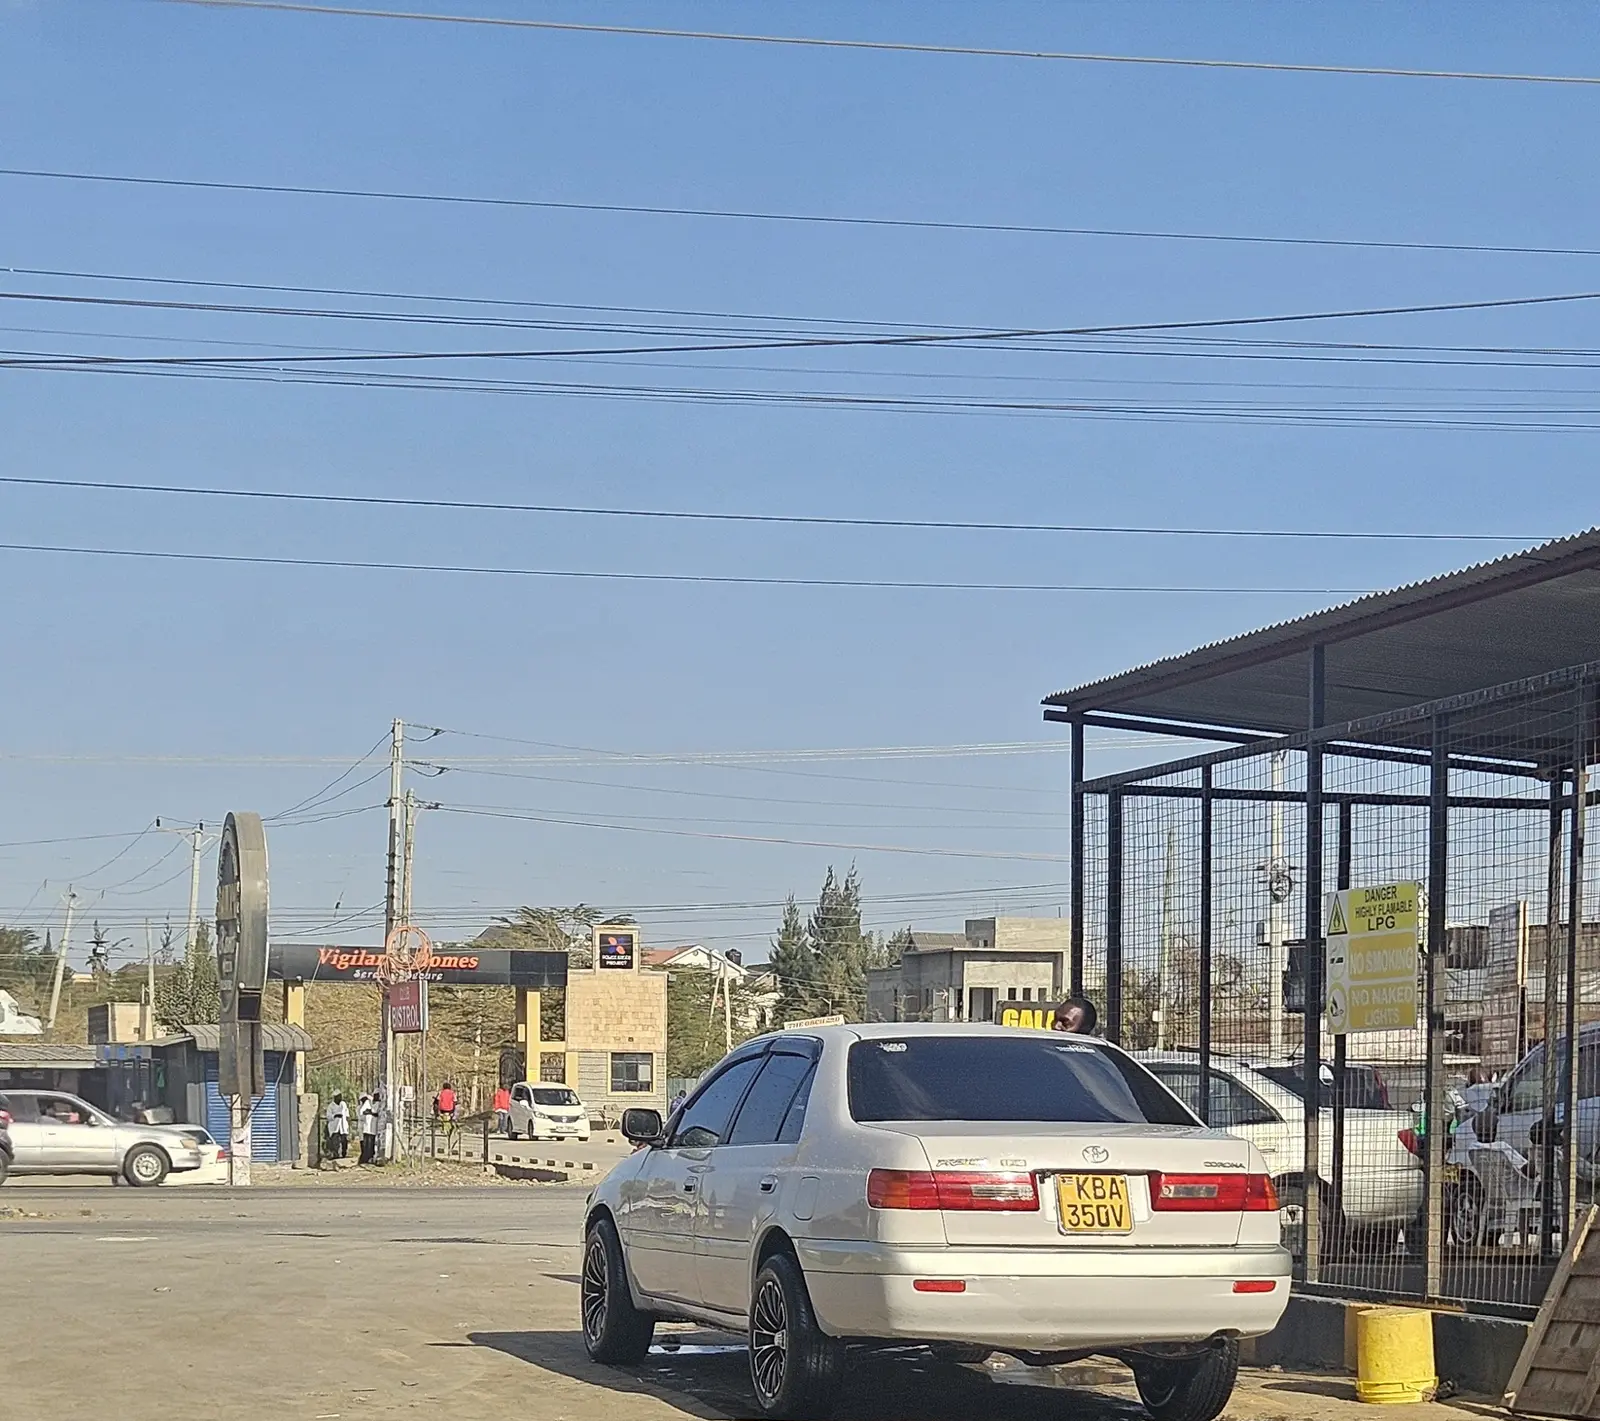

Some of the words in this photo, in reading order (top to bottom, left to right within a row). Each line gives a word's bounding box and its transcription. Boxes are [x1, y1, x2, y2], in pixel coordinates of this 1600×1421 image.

[1364, 886, 1397, 903] DANGER
[1355, 904, 1377, 919] HIGHLY
[1378, 900, 1413, 916] FLAMABLE
[1367, 915, 1396, 931] LPG
[1350, 952, 1365, 975] NO
[1366, 946, 1414, 973] SMOKING
[1351, 989, 1369, 1006] NO
[1371, 986, 1414, 1005] NAKED
[1364, 1007, 1400, 1026] LIGHTS
[1075, 1177, 1122, 1200] KBA
[1066, 1204, 1124, 1228] 350V
